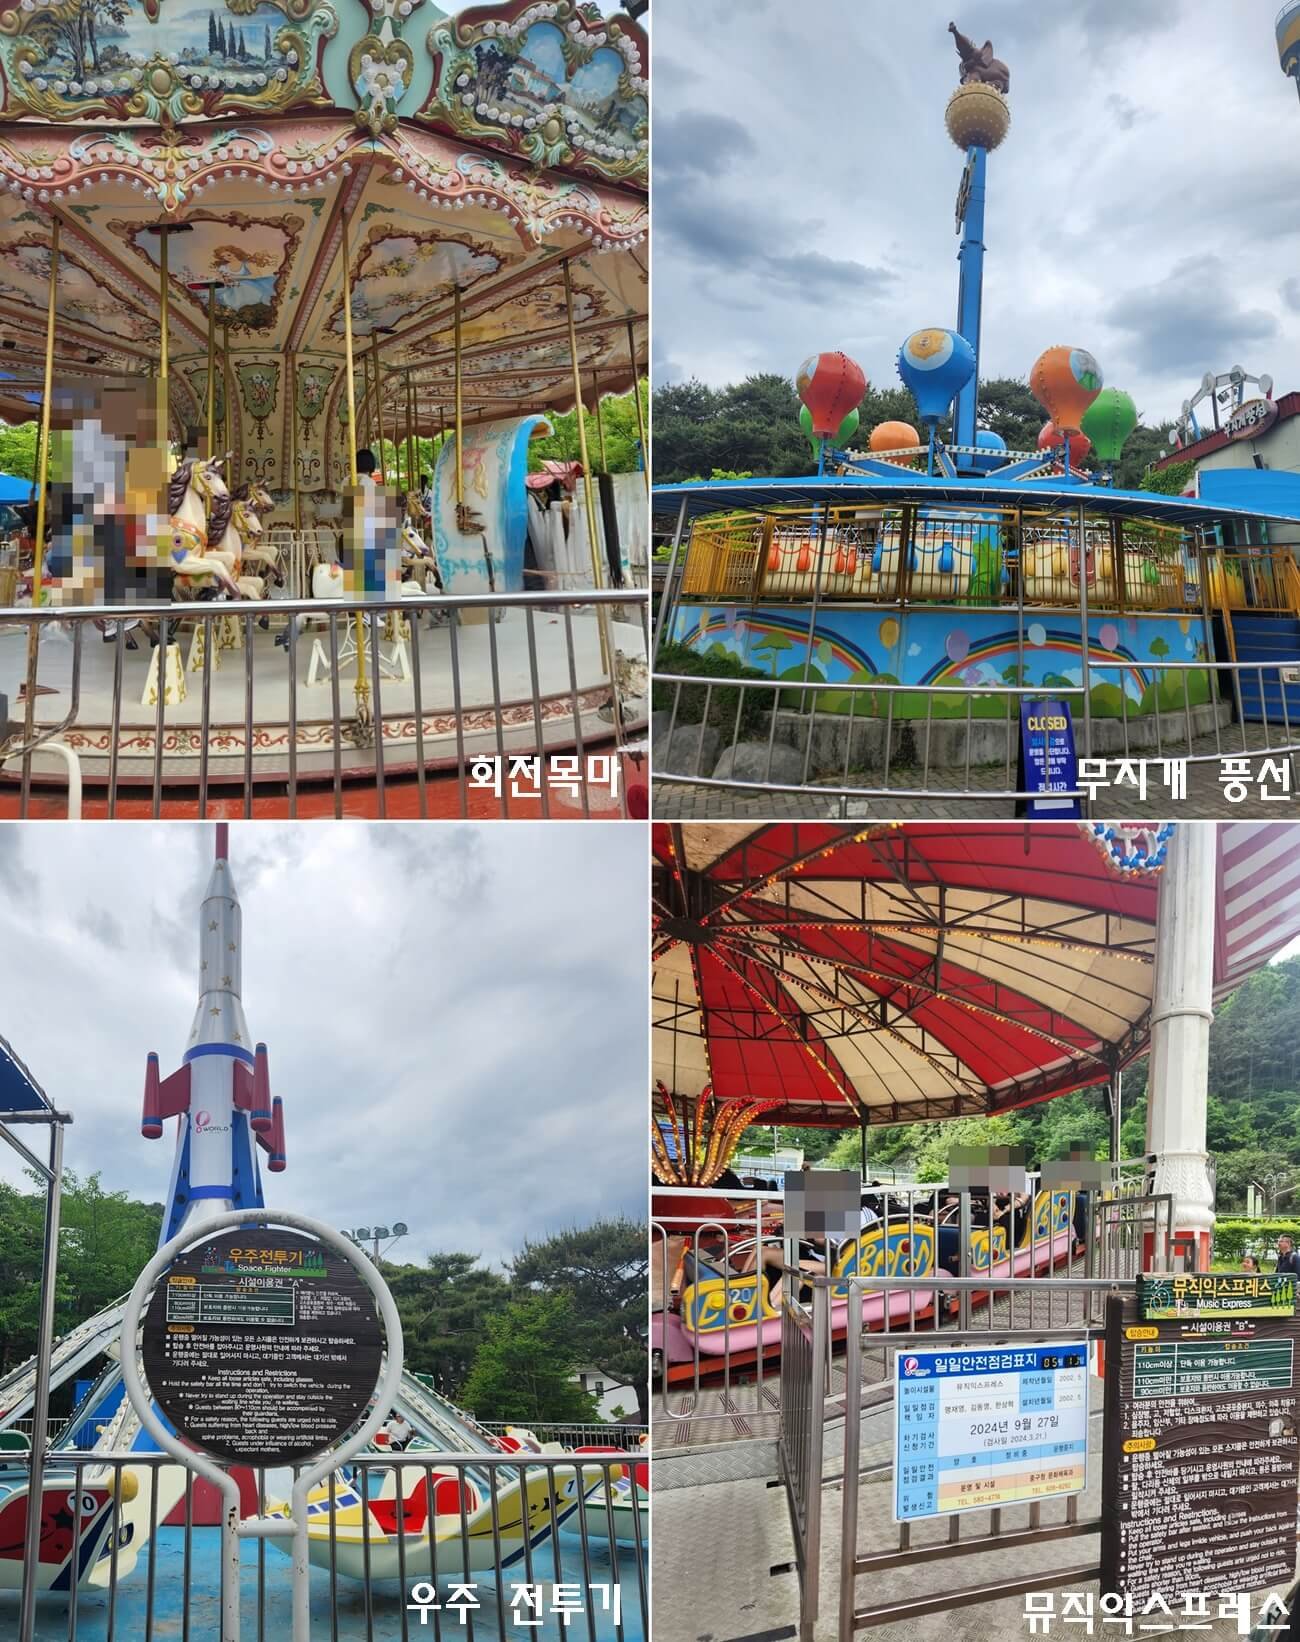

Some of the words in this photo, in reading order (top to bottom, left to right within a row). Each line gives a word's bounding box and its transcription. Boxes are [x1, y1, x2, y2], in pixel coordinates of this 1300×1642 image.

[228, 1248, 302, 1265] 우주전투기
[238, 1264, 262, 1272] Space
[239, 1278, 283, 1288] 시설이용권
[1172, 1278, 1272, 1298] 뮤직익스프레스
[730, 1288, 751, 1303] 20
[1196, 1298, 1219, 1309] Music
[1222, 1299, 1252, 1310] Express
[1190, 1322, 1231, 1332] 시설이용권
[934, 1353, 1037, 1373] 일일안전점검표지
[1138, 1360, 1172, 1369] 110cm이상
[970, 1421, 1008, 1436] 2024년
[1014, 1418, 1031, 1431] 9월
[1037, 1416, 1059, 1428] 27일
[1120, 1517, 1161, 1529] Instructions
[1163, 1513, 1177, 1523] and
